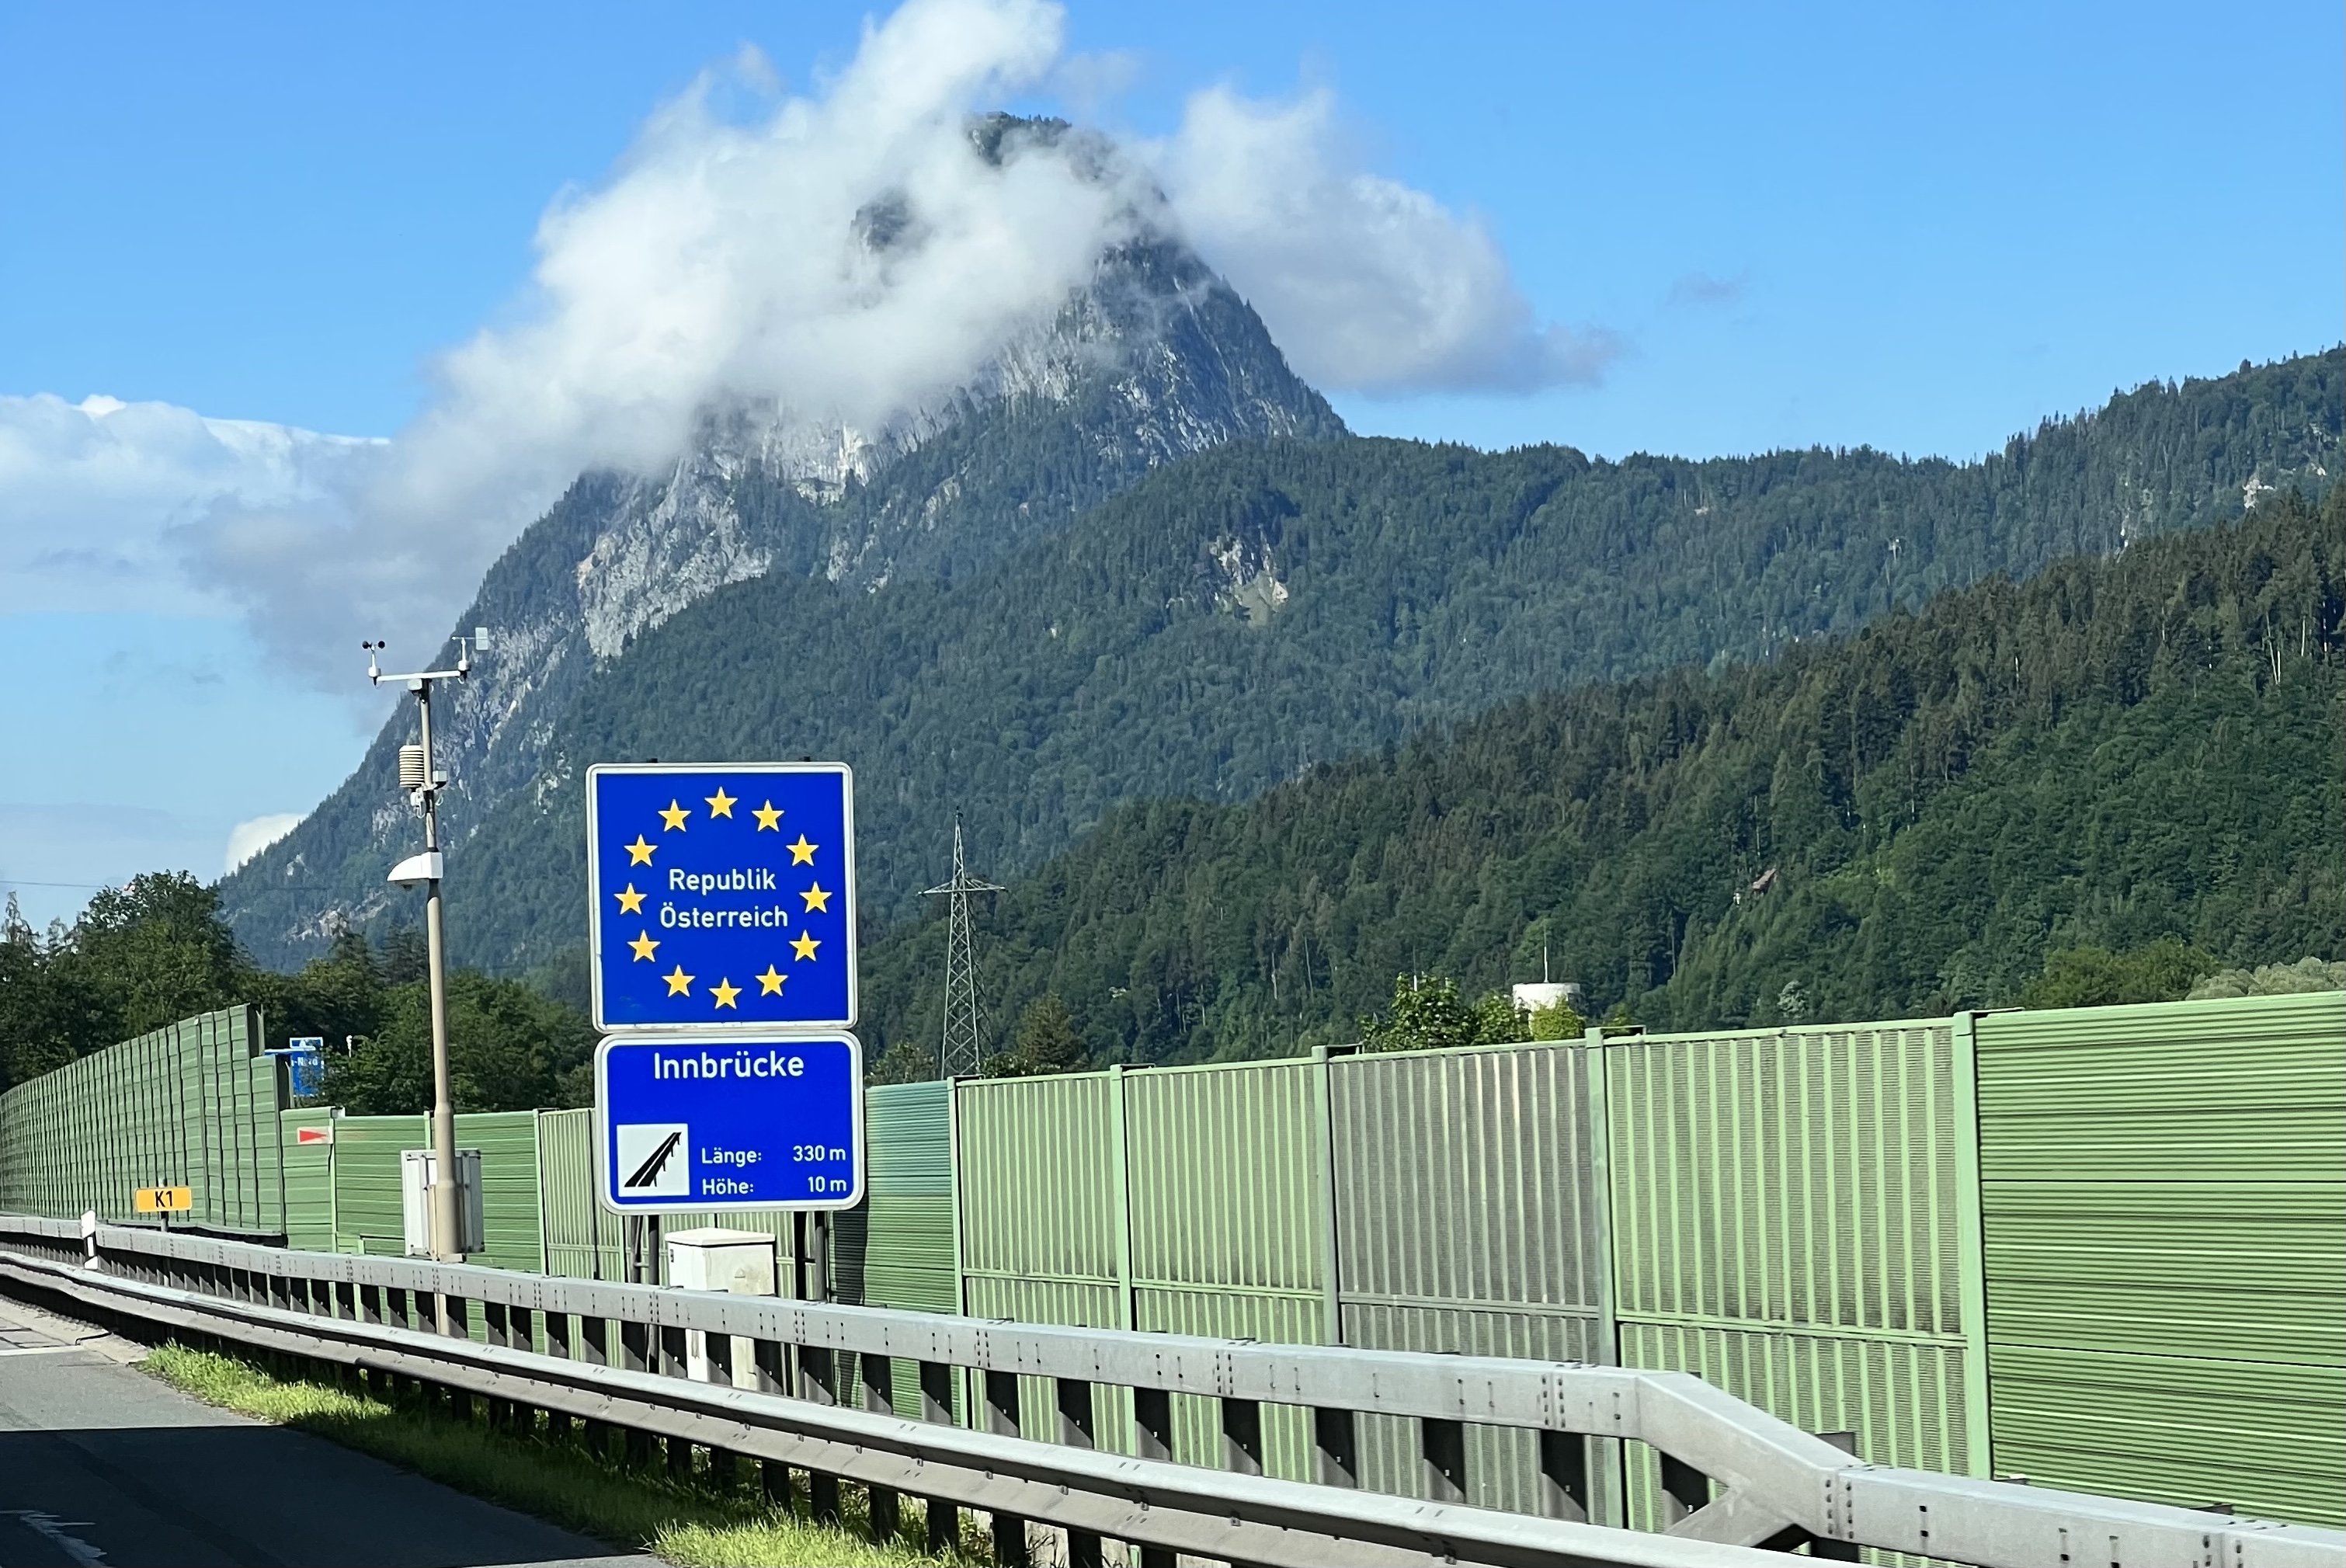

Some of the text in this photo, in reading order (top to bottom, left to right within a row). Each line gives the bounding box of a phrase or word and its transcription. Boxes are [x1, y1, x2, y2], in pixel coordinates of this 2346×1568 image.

[669, 867, 777, 895] Republik
[660, 901, 788, 928] Österreich
[654, 1050, 805, 1080] Innbrücke
[701, 1145, 846, 1167] Länge: 330 m
[702, 1176, 848, 1195] Höhe: 10 m
[155, 1190, 173, 1208] K1
